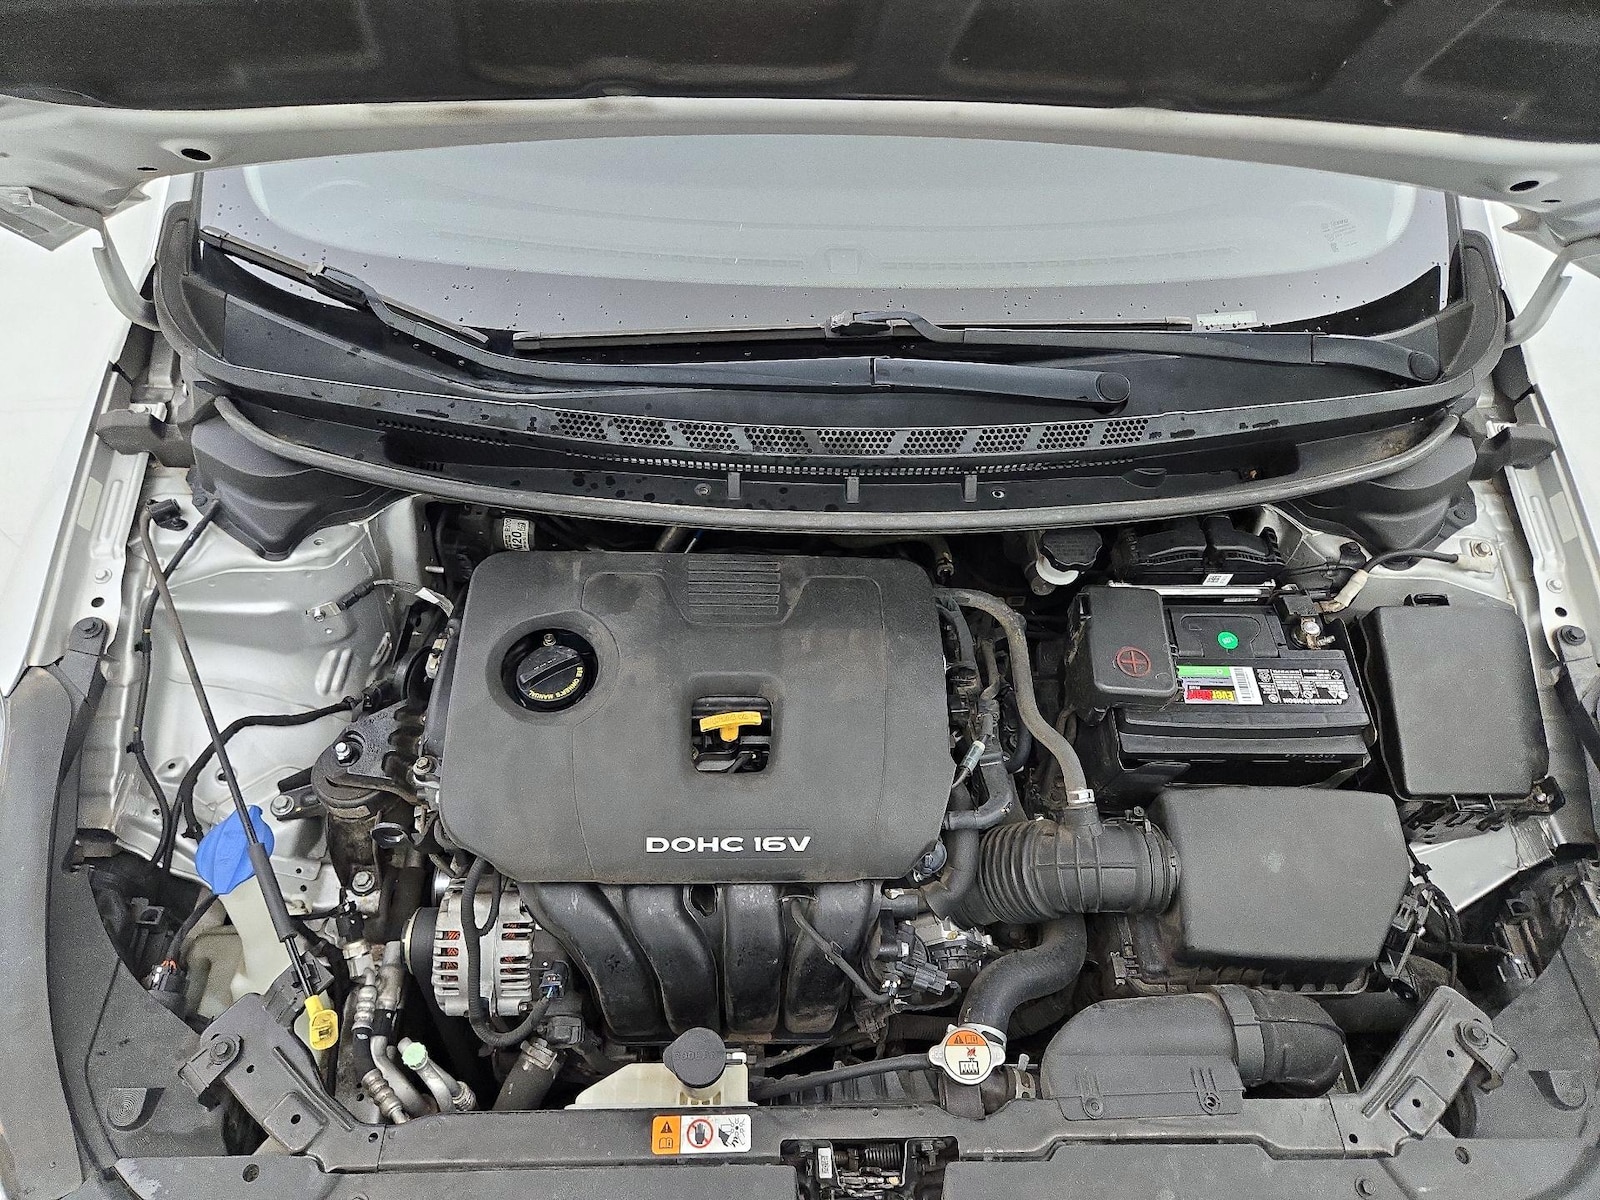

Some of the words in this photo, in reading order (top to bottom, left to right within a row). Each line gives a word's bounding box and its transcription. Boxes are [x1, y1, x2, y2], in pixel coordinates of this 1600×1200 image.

[528, 689, 554, 700] MANUAL
[645, 837, 745, 853] DOHC
[753, 837, 812, 852] 16V
